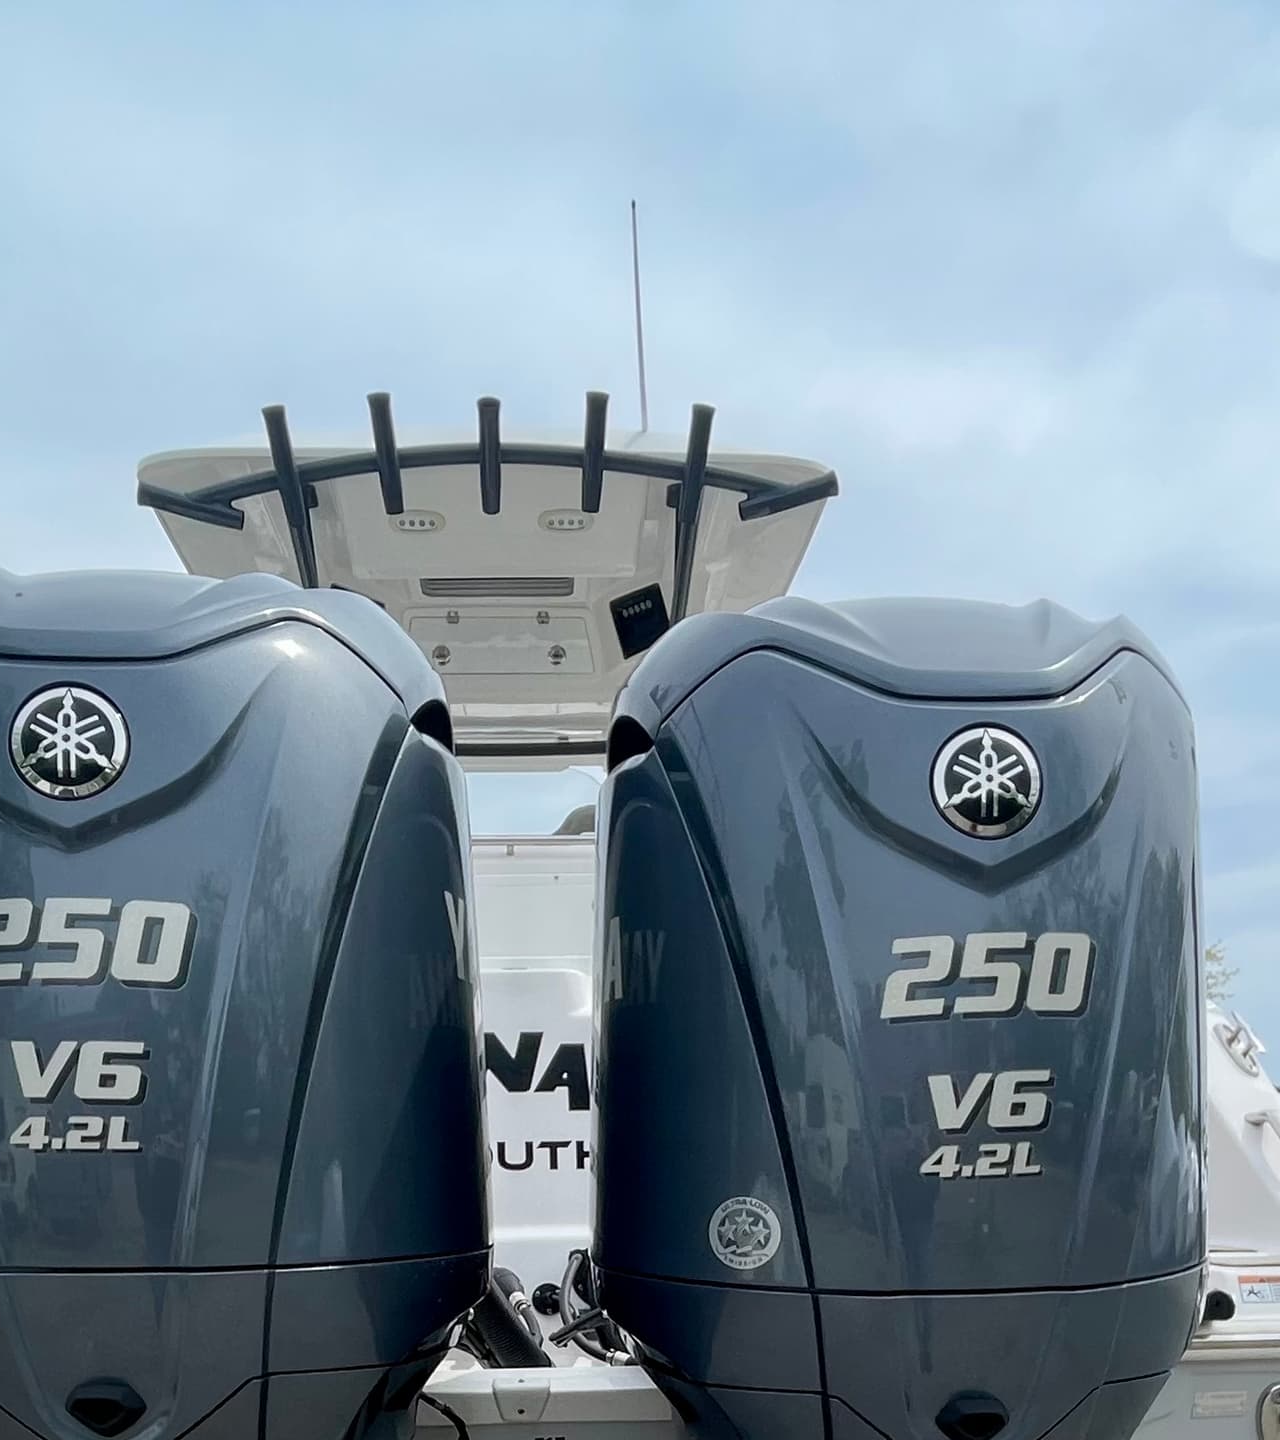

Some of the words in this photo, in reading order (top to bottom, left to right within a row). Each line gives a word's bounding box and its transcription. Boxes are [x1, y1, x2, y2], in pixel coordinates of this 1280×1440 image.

[880, 932, 1094, 1021] 250
[10, 1041, 151, 1104] V6
[927, 1069, 1055, 1133] V6
[9, 1115, 142, 1152] 4.2L
[489, 1140, 590, 1170] UTH
[920, 1141, 1042, 1179] 4.2L
